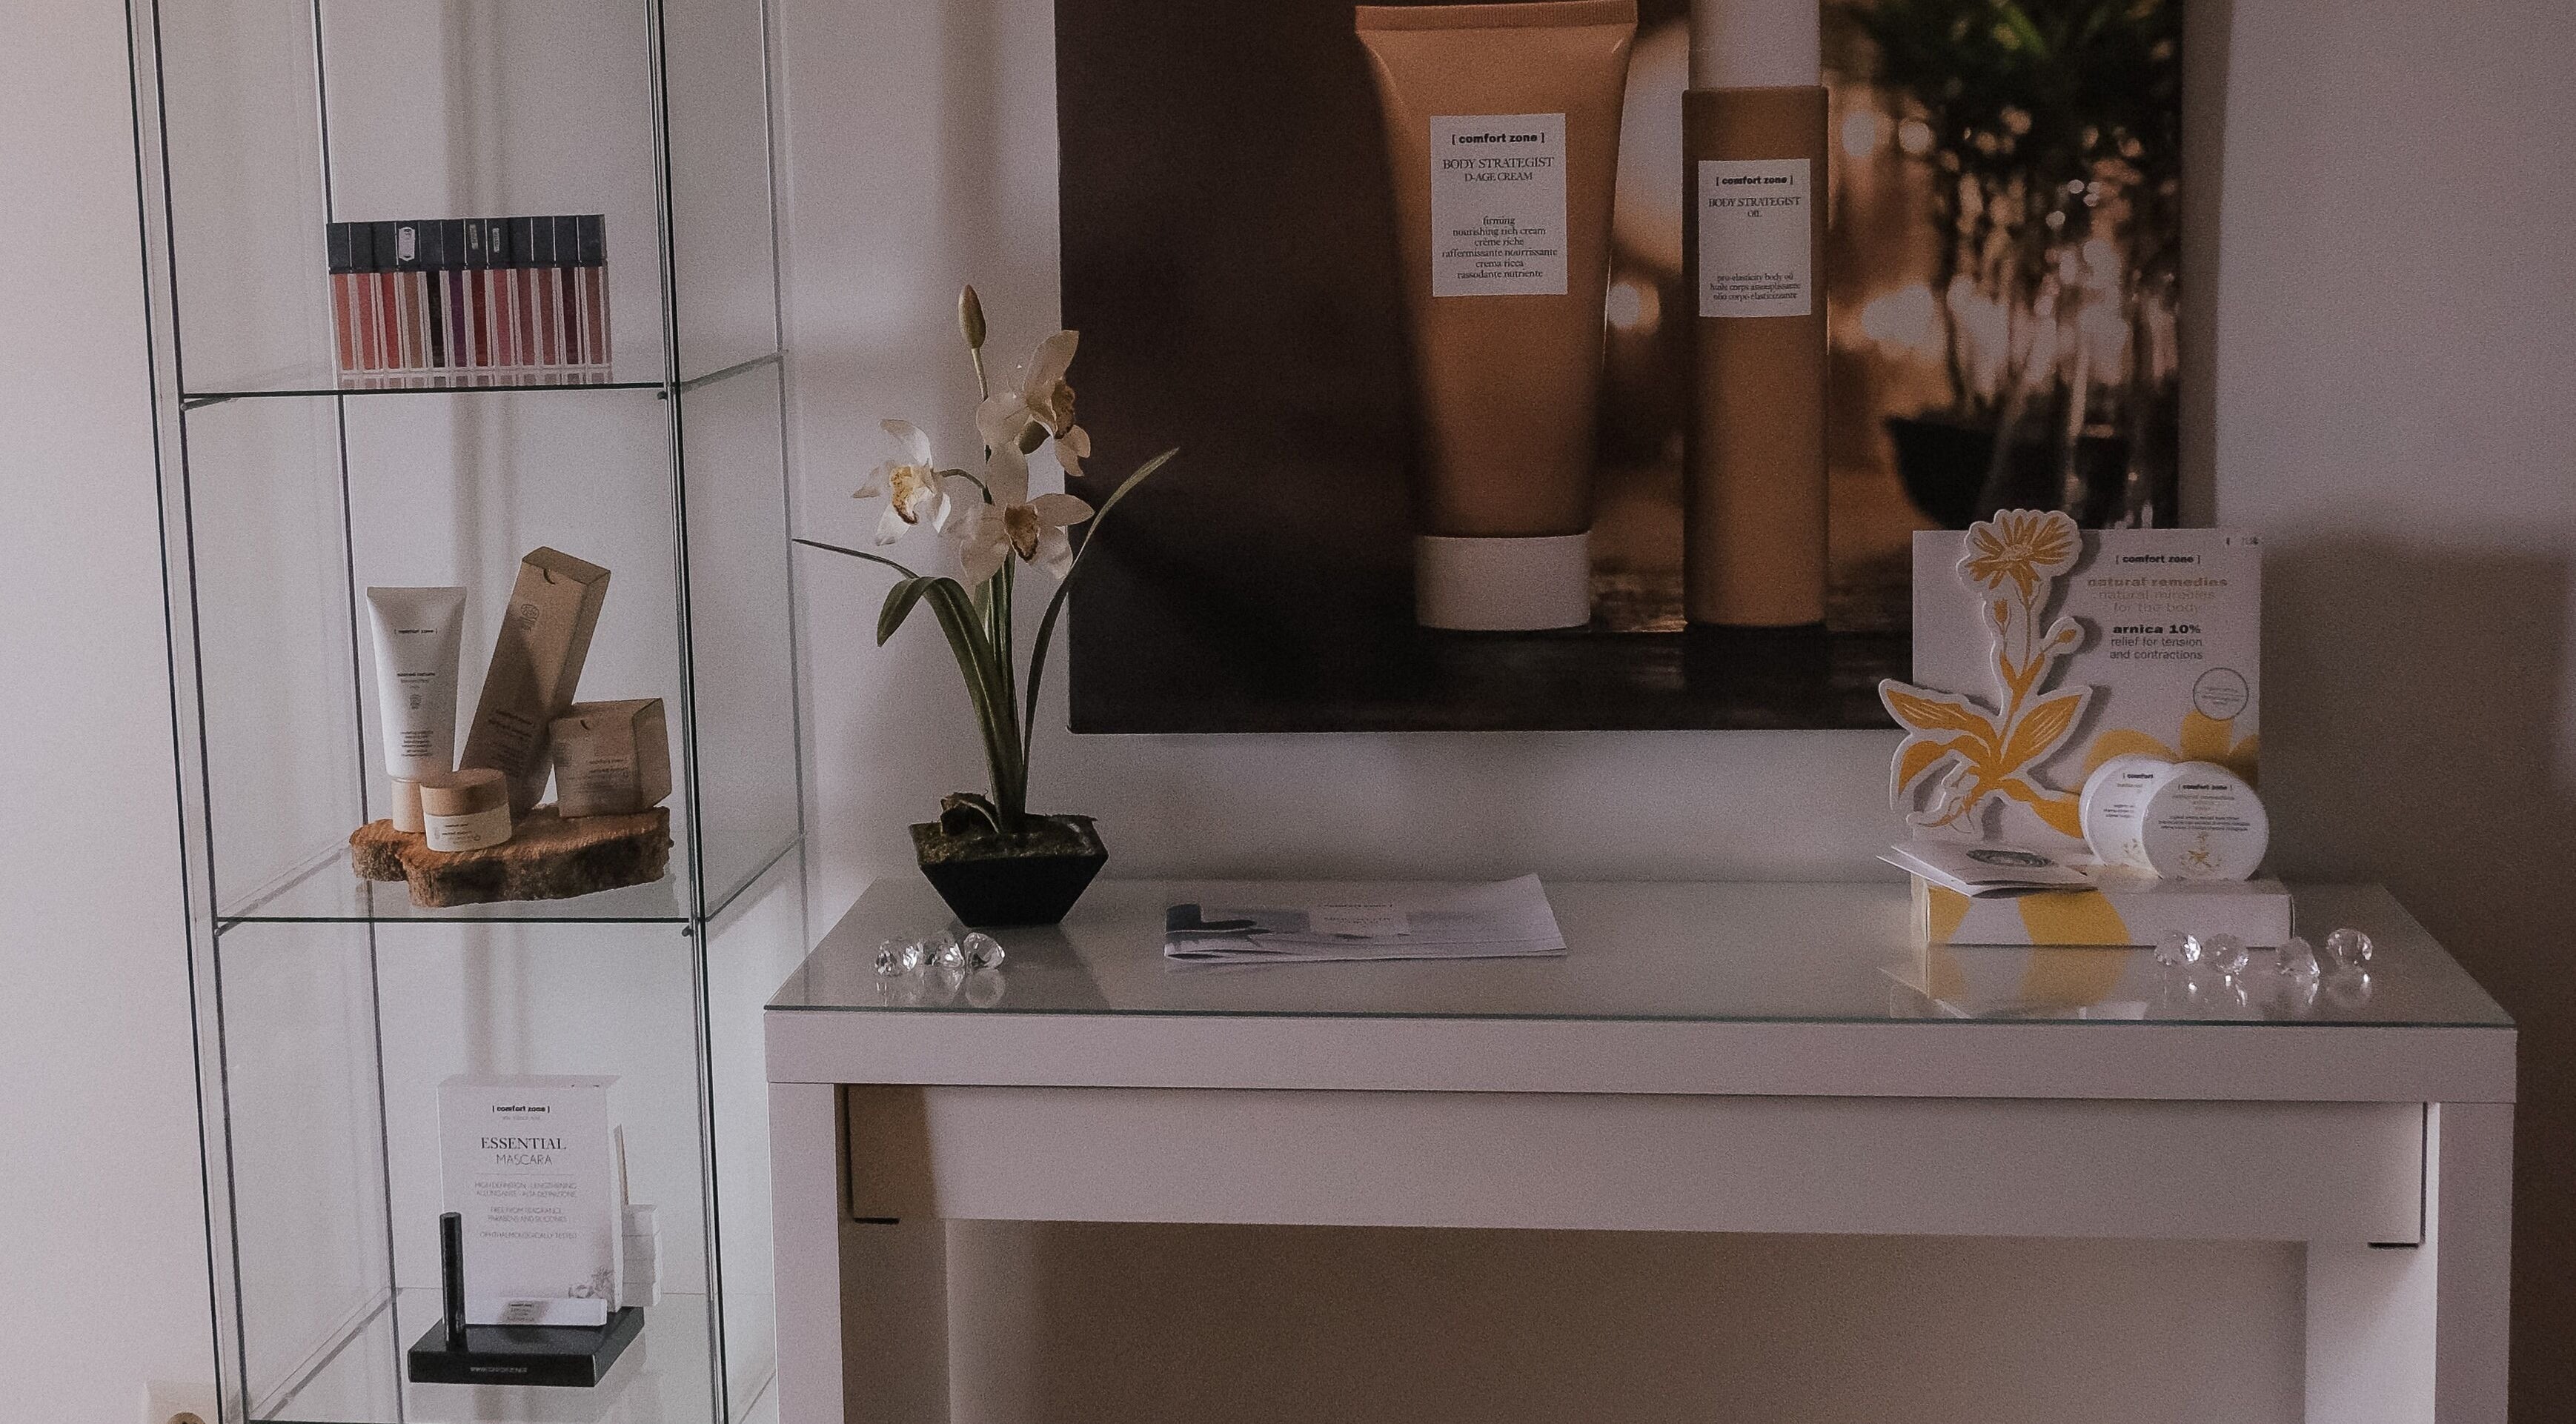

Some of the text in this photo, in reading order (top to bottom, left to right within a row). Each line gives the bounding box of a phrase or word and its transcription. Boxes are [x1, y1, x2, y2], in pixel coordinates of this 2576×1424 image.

[1458, 133, 1506, 144] comfort
[1509, 134, 1538, 143] zone
[1443, 157, 1554, 170] BODY STRATEGIST
[1464, 171, 1533, 182] D-AGE CREAM
[1722, 176, 1762, 184] comfort
[1708, 196, 1802, 207] BODY STRATEGIST
[1483, 216, 1516, 226] firming
[1453, 227, 1498, 236] nourishing
[1501, 227, 1518, 236] rich
[1503, 237, 1524, 246] riche
[1504, 269, 1543, 278] nutriente
[2122, 555, 2165, 563] comfort
[2087, 577, 2228, 587] natural remedies
[2113, 625, 2201, 633] arnica 10%
[2111, 637, 2202, 646] relief for tension
[2110, 651, 2203, 659] and contractions
[481, 1137, 567, 1150] ESSENTIAL
[496, 1154, 553, 1165] MASCARA
